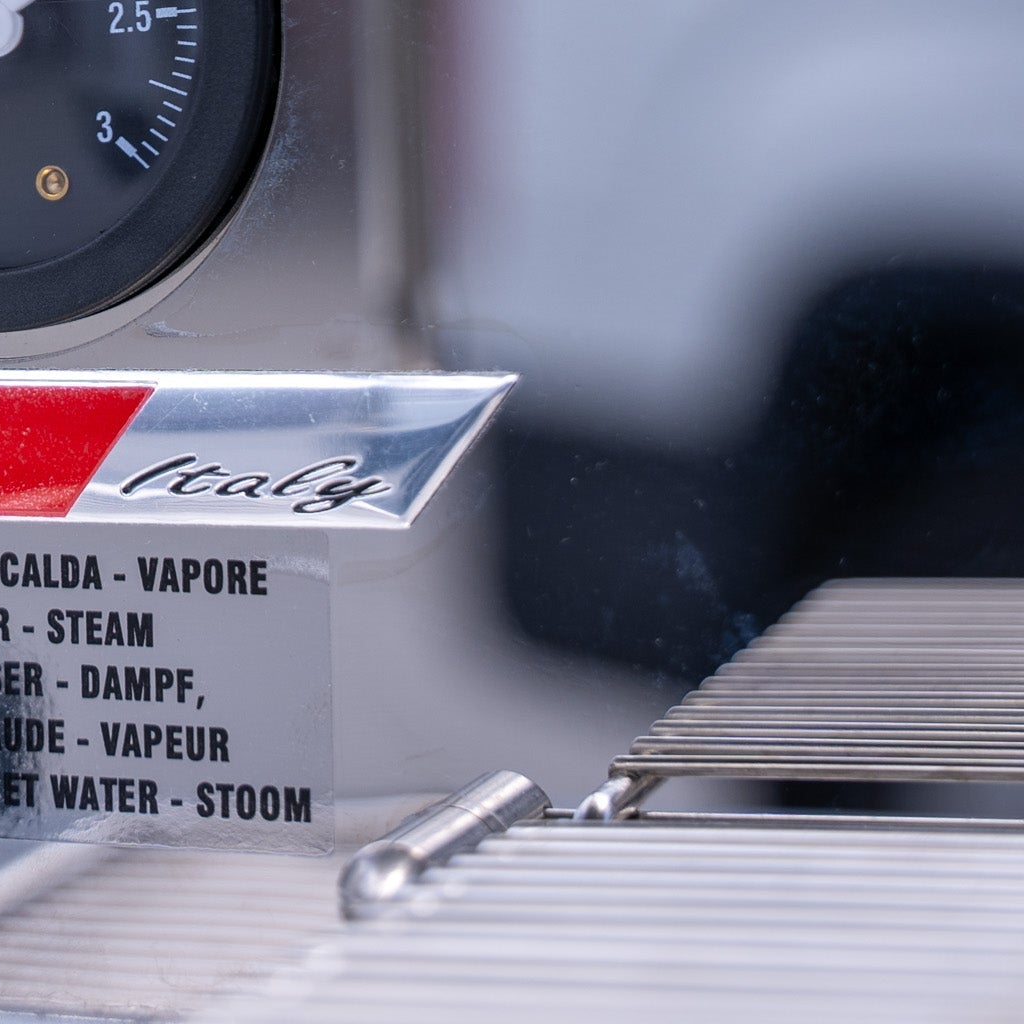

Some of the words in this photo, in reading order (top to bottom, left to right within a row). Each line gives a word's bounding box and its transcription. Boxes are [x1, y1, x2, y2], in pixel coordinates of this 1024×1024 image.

[108, 0, 153, 34] 2.5
[95, 110, 113, 143] 3
[119, 453, 393, 515] Italy
[0, 551, 103, 590] CALDA
[137, 556, 268, 595] VAPORE
[46, 609, 154, 647] STEAM
[80, 664, 205, 709] DAMPF,
[99, 721, 230, 762] VAPEUR
[49, 774, 160, 814] WATER
[196, 781, 312, 822] STOOM
